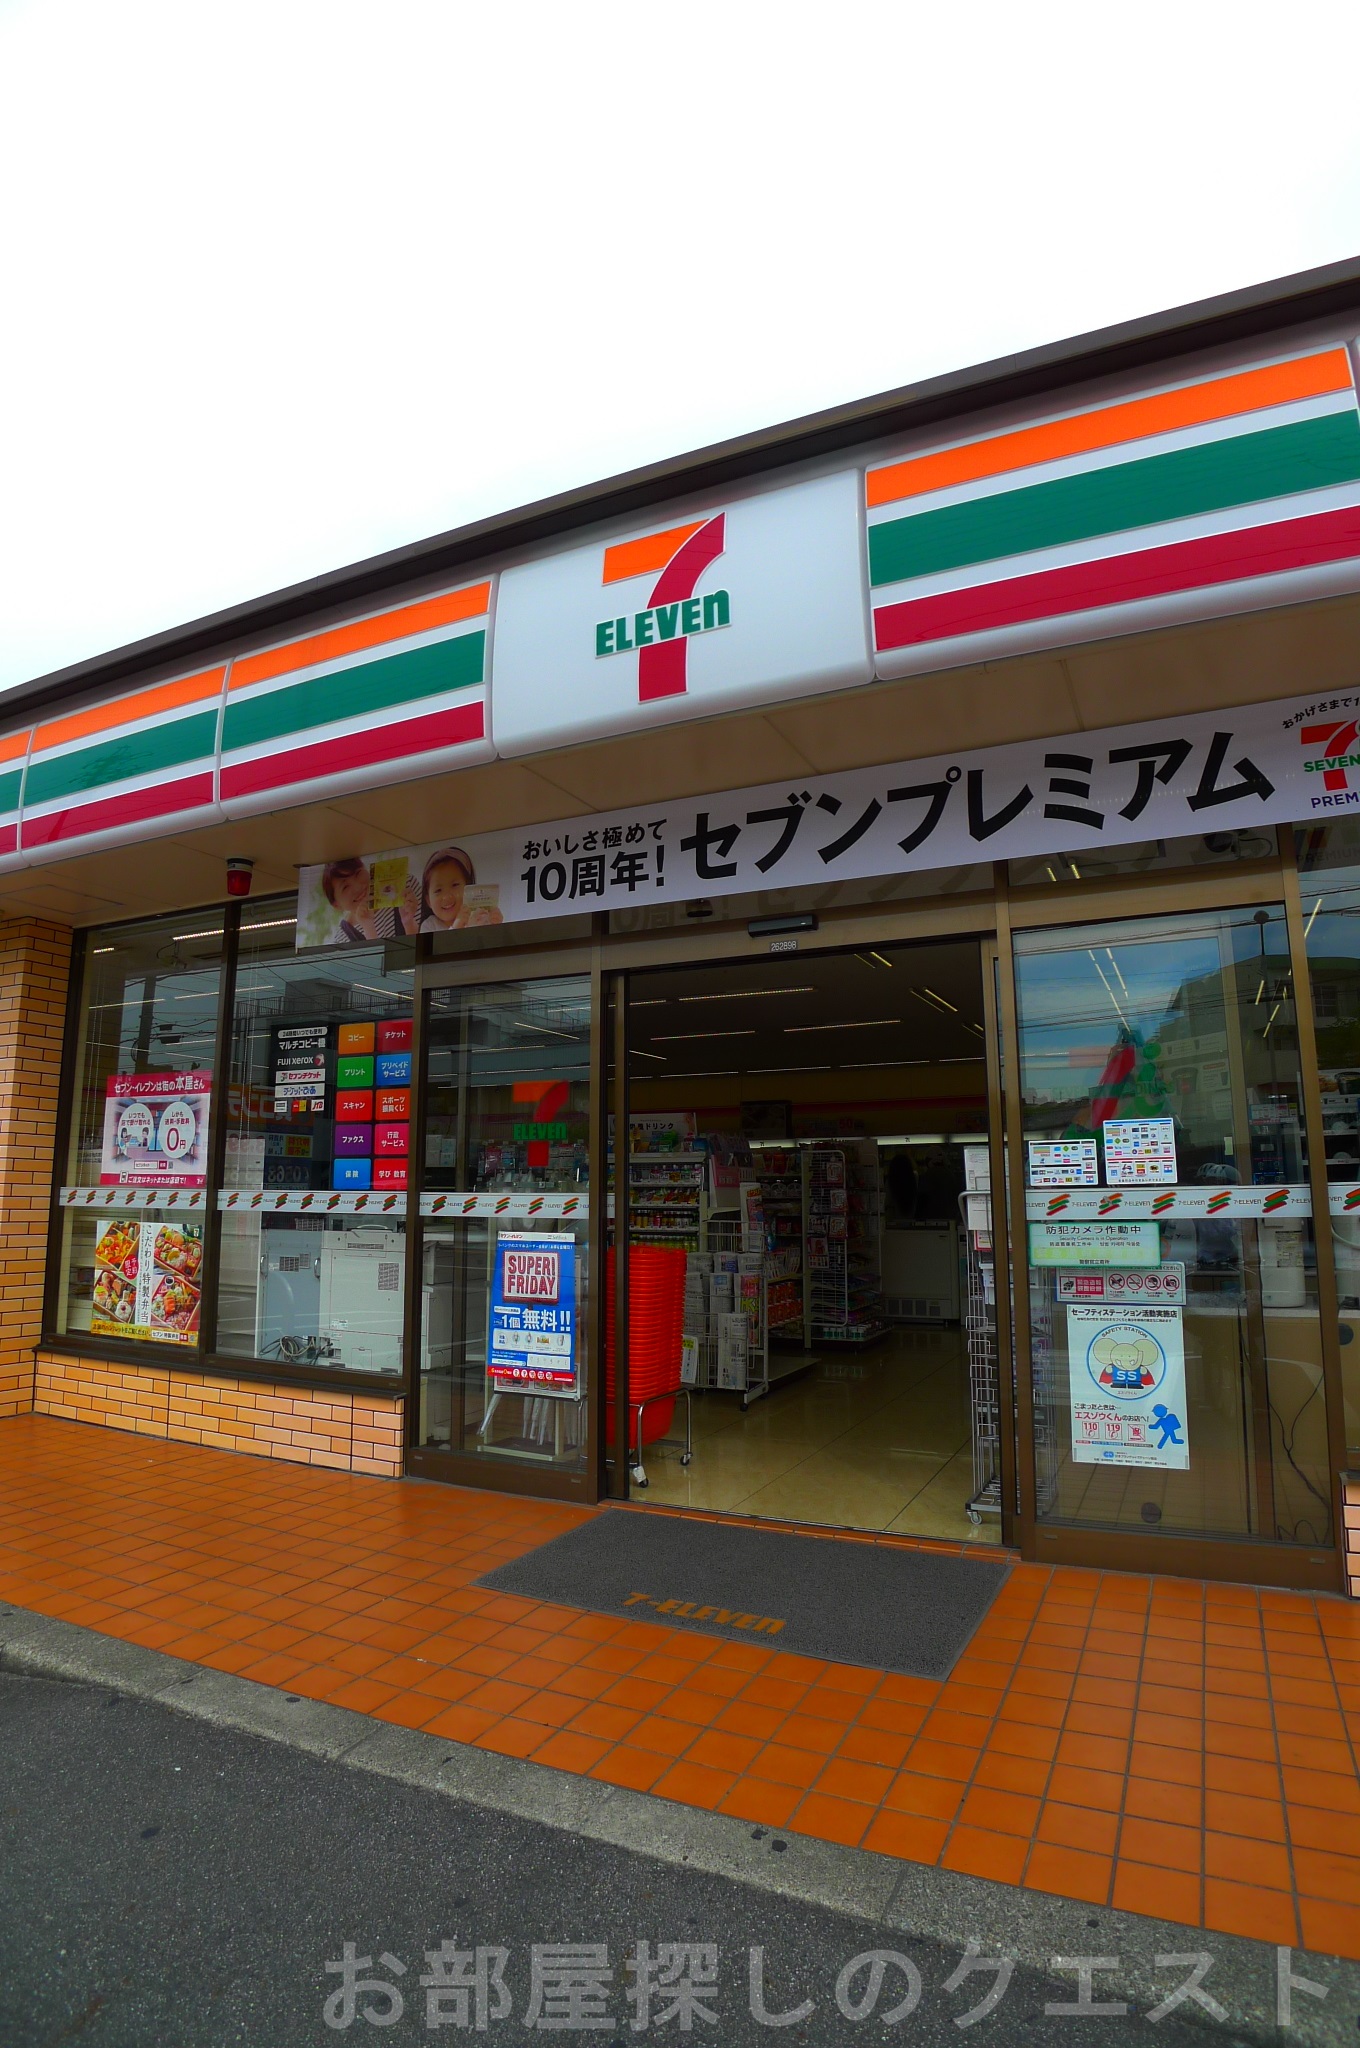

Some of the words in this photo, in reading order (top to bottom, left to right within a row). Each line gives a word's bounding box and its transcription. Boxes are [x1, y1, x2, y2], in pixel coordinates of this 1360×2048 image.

[602, 511, 726, 704] 7
[680, 731, 1276, 880] セブンプレミアム
[522, 818, 668, 861] おいしさ極めて
[520, 844, 665, 903] 10周年!
[347, 1033, 366, 1042] コピー
[384, 1030, 407, 1039] チケット
[278, 1038, 326, 1050] マルチコピー機
[381, 1060, 409, 1069] プリペイド
[288, 1071, 322, 1080] セブンチケット
[344, 1067, 366, 1077] プリント
[383, 1068, 406, 1078] サービス
[382, 1096, 405, 1104] スポーツ
[342, 1101, 366, 1110] スキャン
[342, 1135, 365, 1144] ファクス
[381, 1139, 405, 1148] サービス
[1045, 1225, 1142, 1235] 防犯カメラ作動中
[507, 1254, 556, 1277] SUPER!
[140, 1224, 153, 1323] こだわり特製弁当
[507, 1274, 556, 1296] FRIDAY
[1071, 1307, 1178, 1319] セーフティステーション活動実施店
[1101, 1326, 1122, 1338] SAFETY
[1123, 1326, 1148, 1339] STATION
[1116, 1370, 1137, 1381] SS
[1083, 1422, 1098, 1431] 110
[1106, 1423, 1121, 1432] 119
